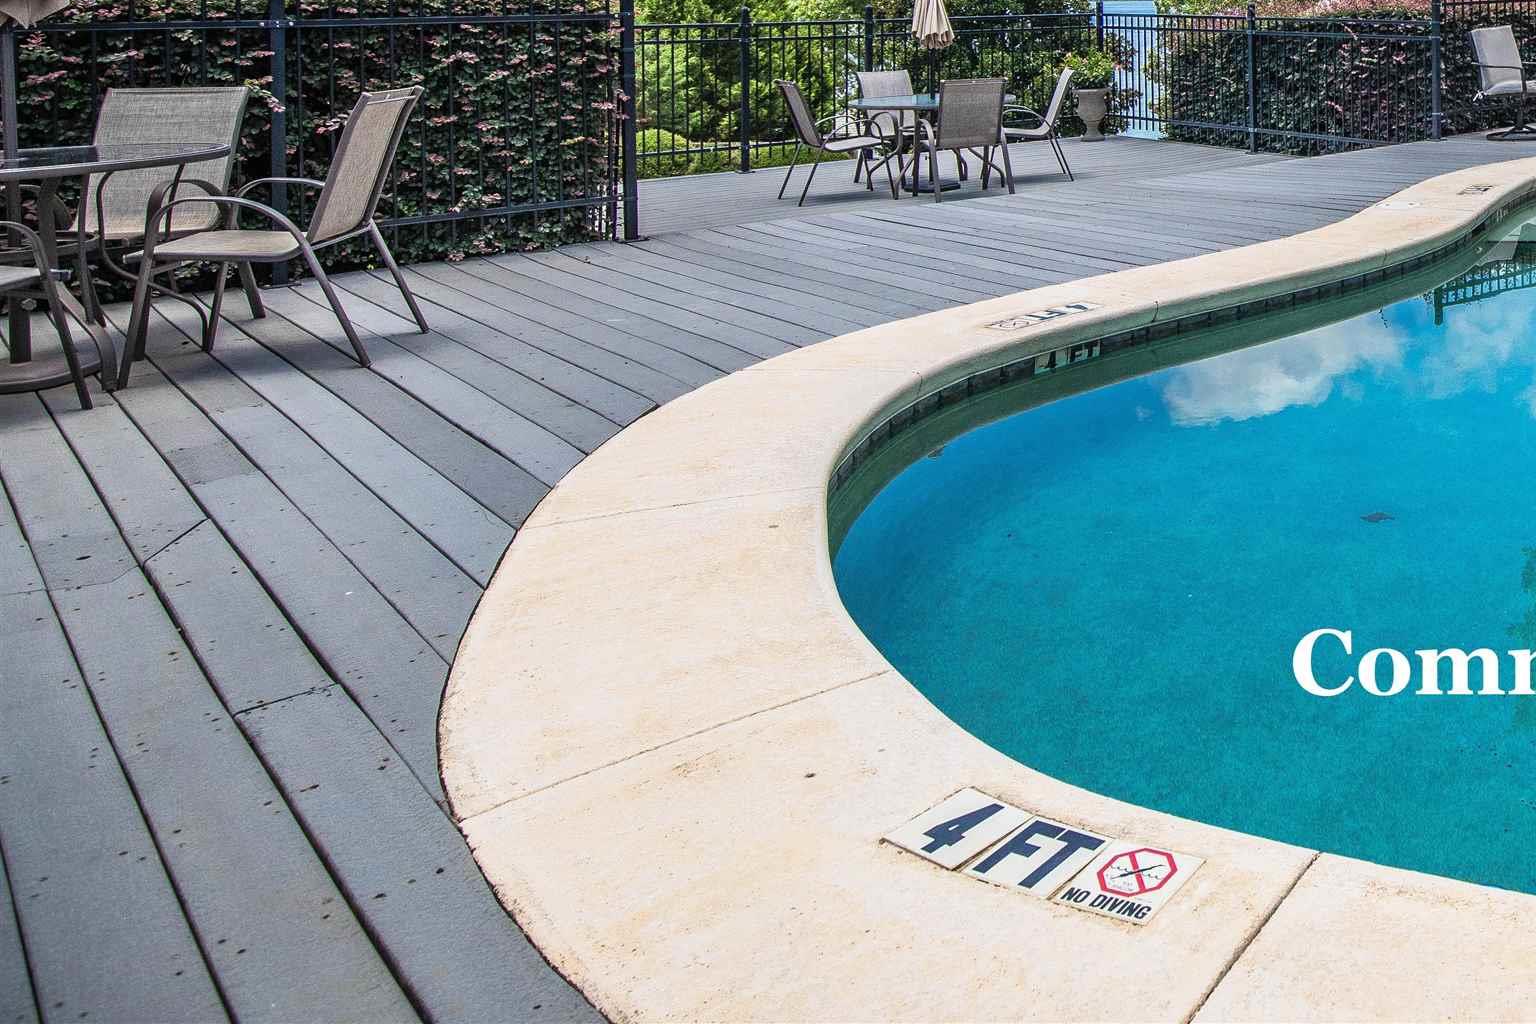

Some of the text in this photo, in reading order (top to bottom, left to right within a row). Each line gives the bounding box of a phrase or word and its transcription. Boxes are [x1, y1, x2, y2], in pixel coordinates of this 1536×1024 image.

[920, 803, 1106, 889] 4 FT
[1060, 887, 1152, 920] NO DIVING
